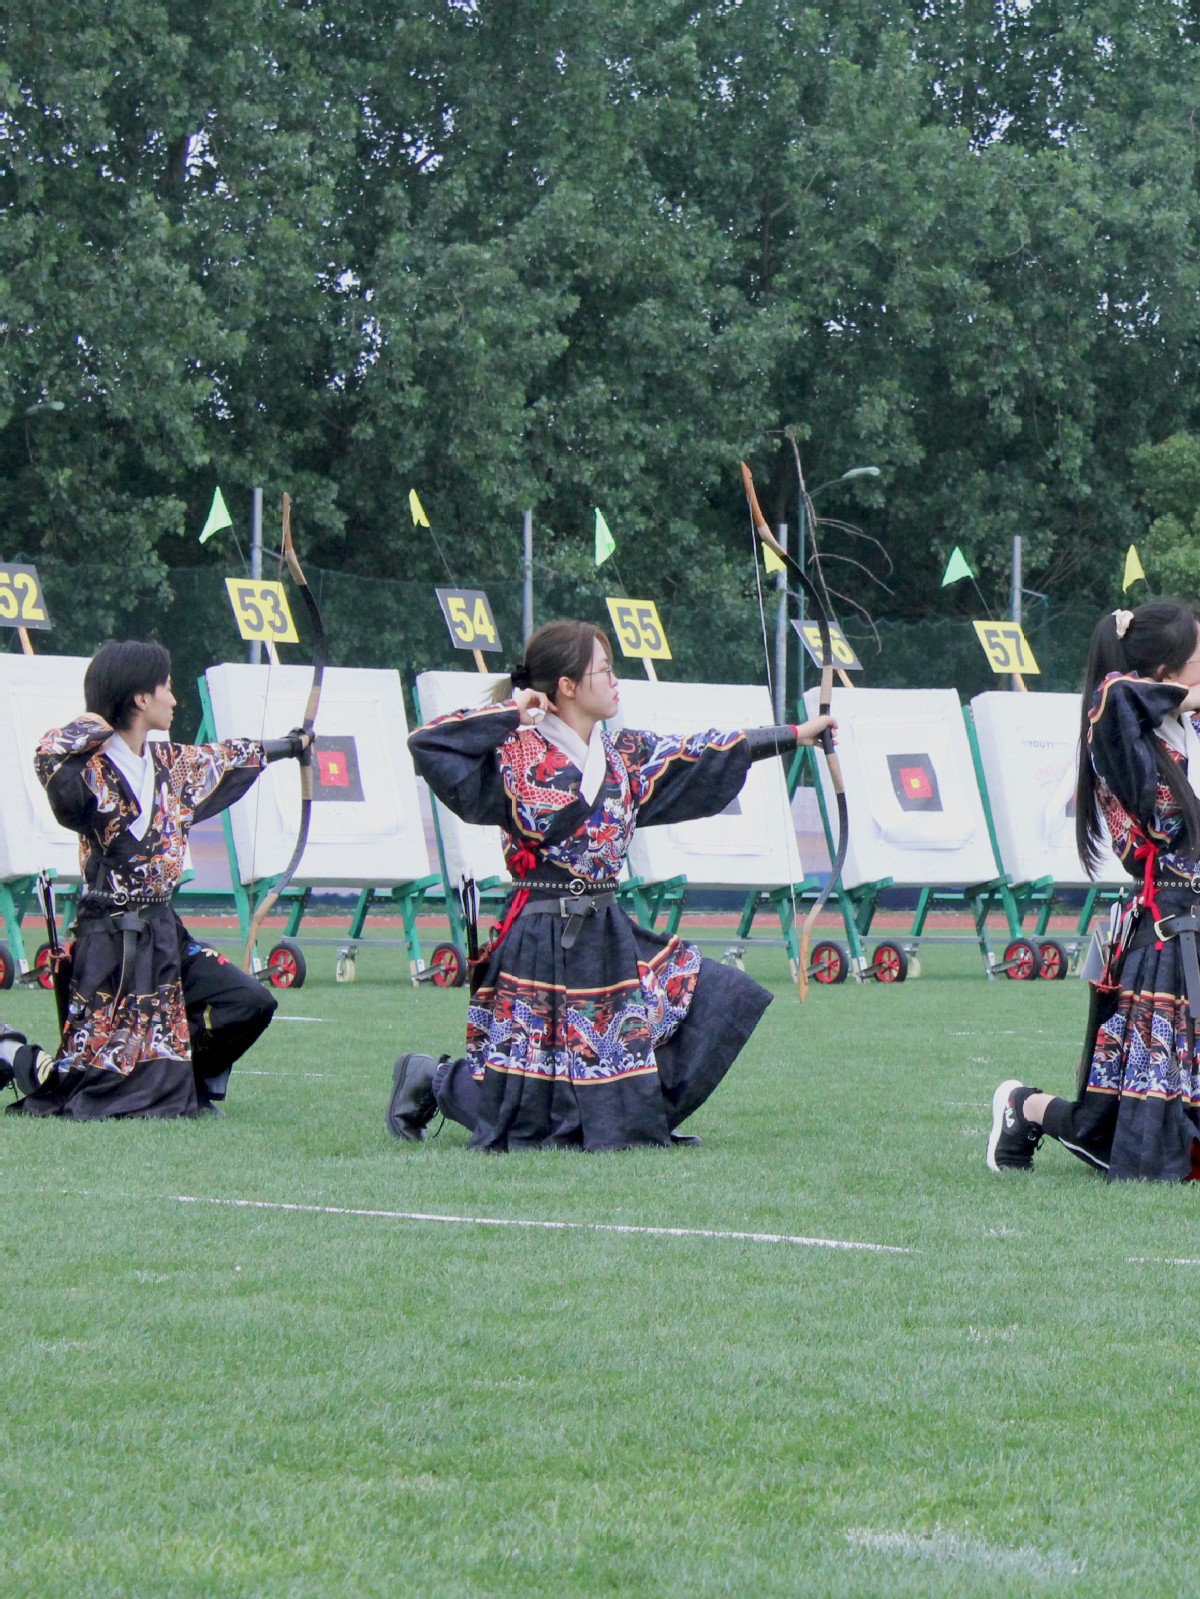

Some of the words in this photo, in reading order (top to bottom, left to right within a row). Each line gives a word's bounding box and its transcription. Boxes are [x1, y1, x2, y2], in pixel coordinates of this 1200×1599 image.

[237, 587, 288, 634] 53
[447, 597, 495, 643] 54
[616, 606, 661, 650] 55
[983, 629, 1025, 667] 57
